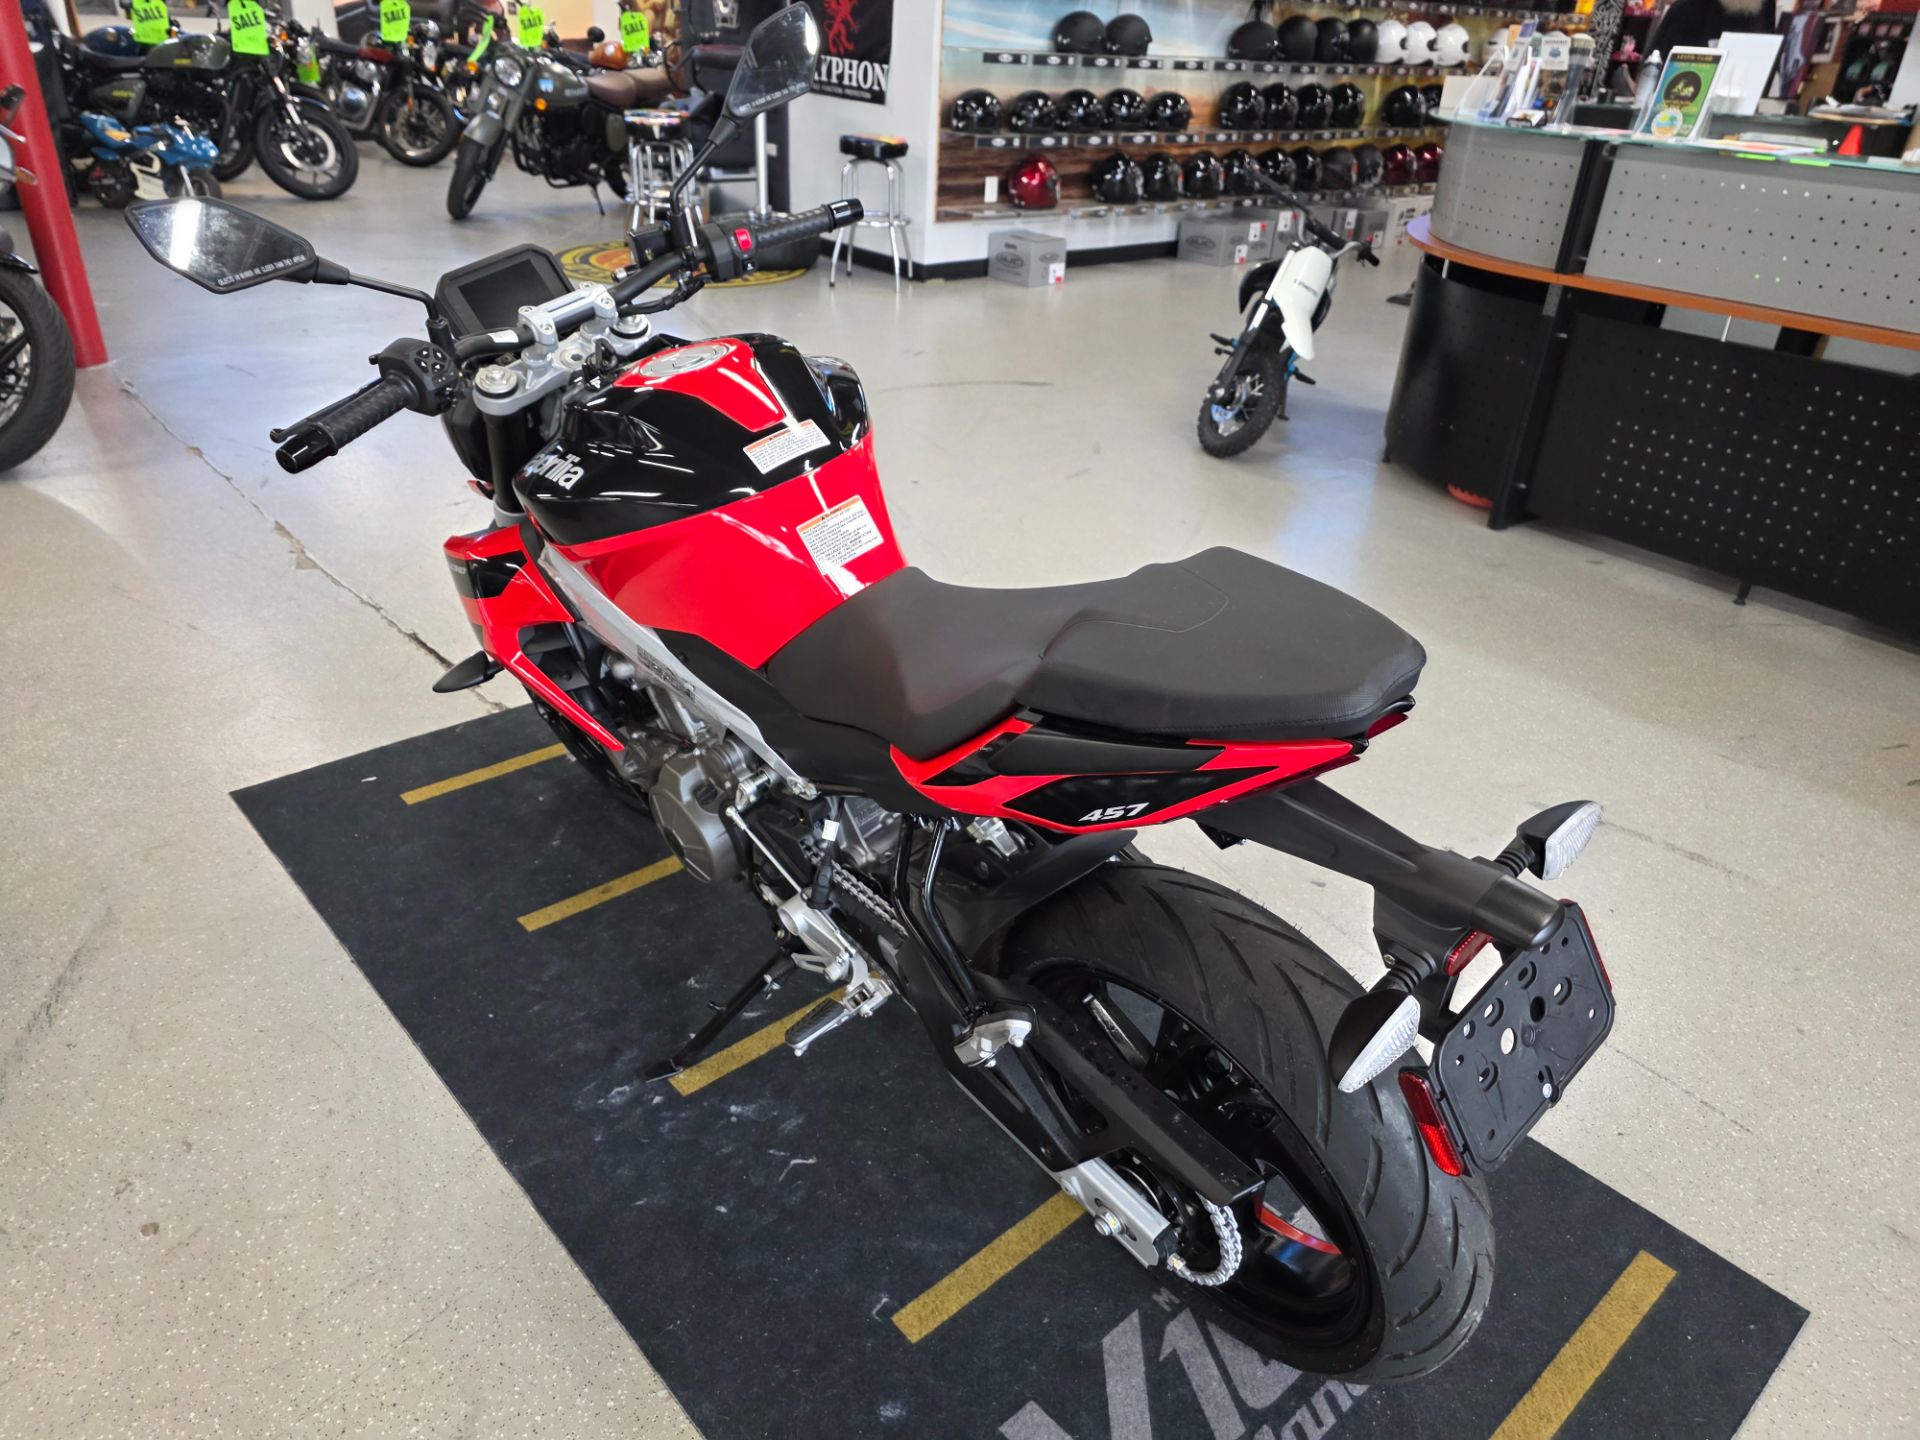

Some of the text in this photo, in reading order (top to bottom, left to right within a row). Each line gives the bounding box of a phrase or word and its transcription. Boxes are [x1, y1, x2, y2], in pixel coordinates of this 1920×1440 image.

[134, 6, 165, 23] SALE
[231, 11, 261, 31] SALE
[384, 9, 407, 23] SALE
[521, 15, 543, 30] SALE
[624, 20, 645, 35] SALE
[814, 55, 889, 93] YPHON
[1079, 802, 1149, 821] 457
